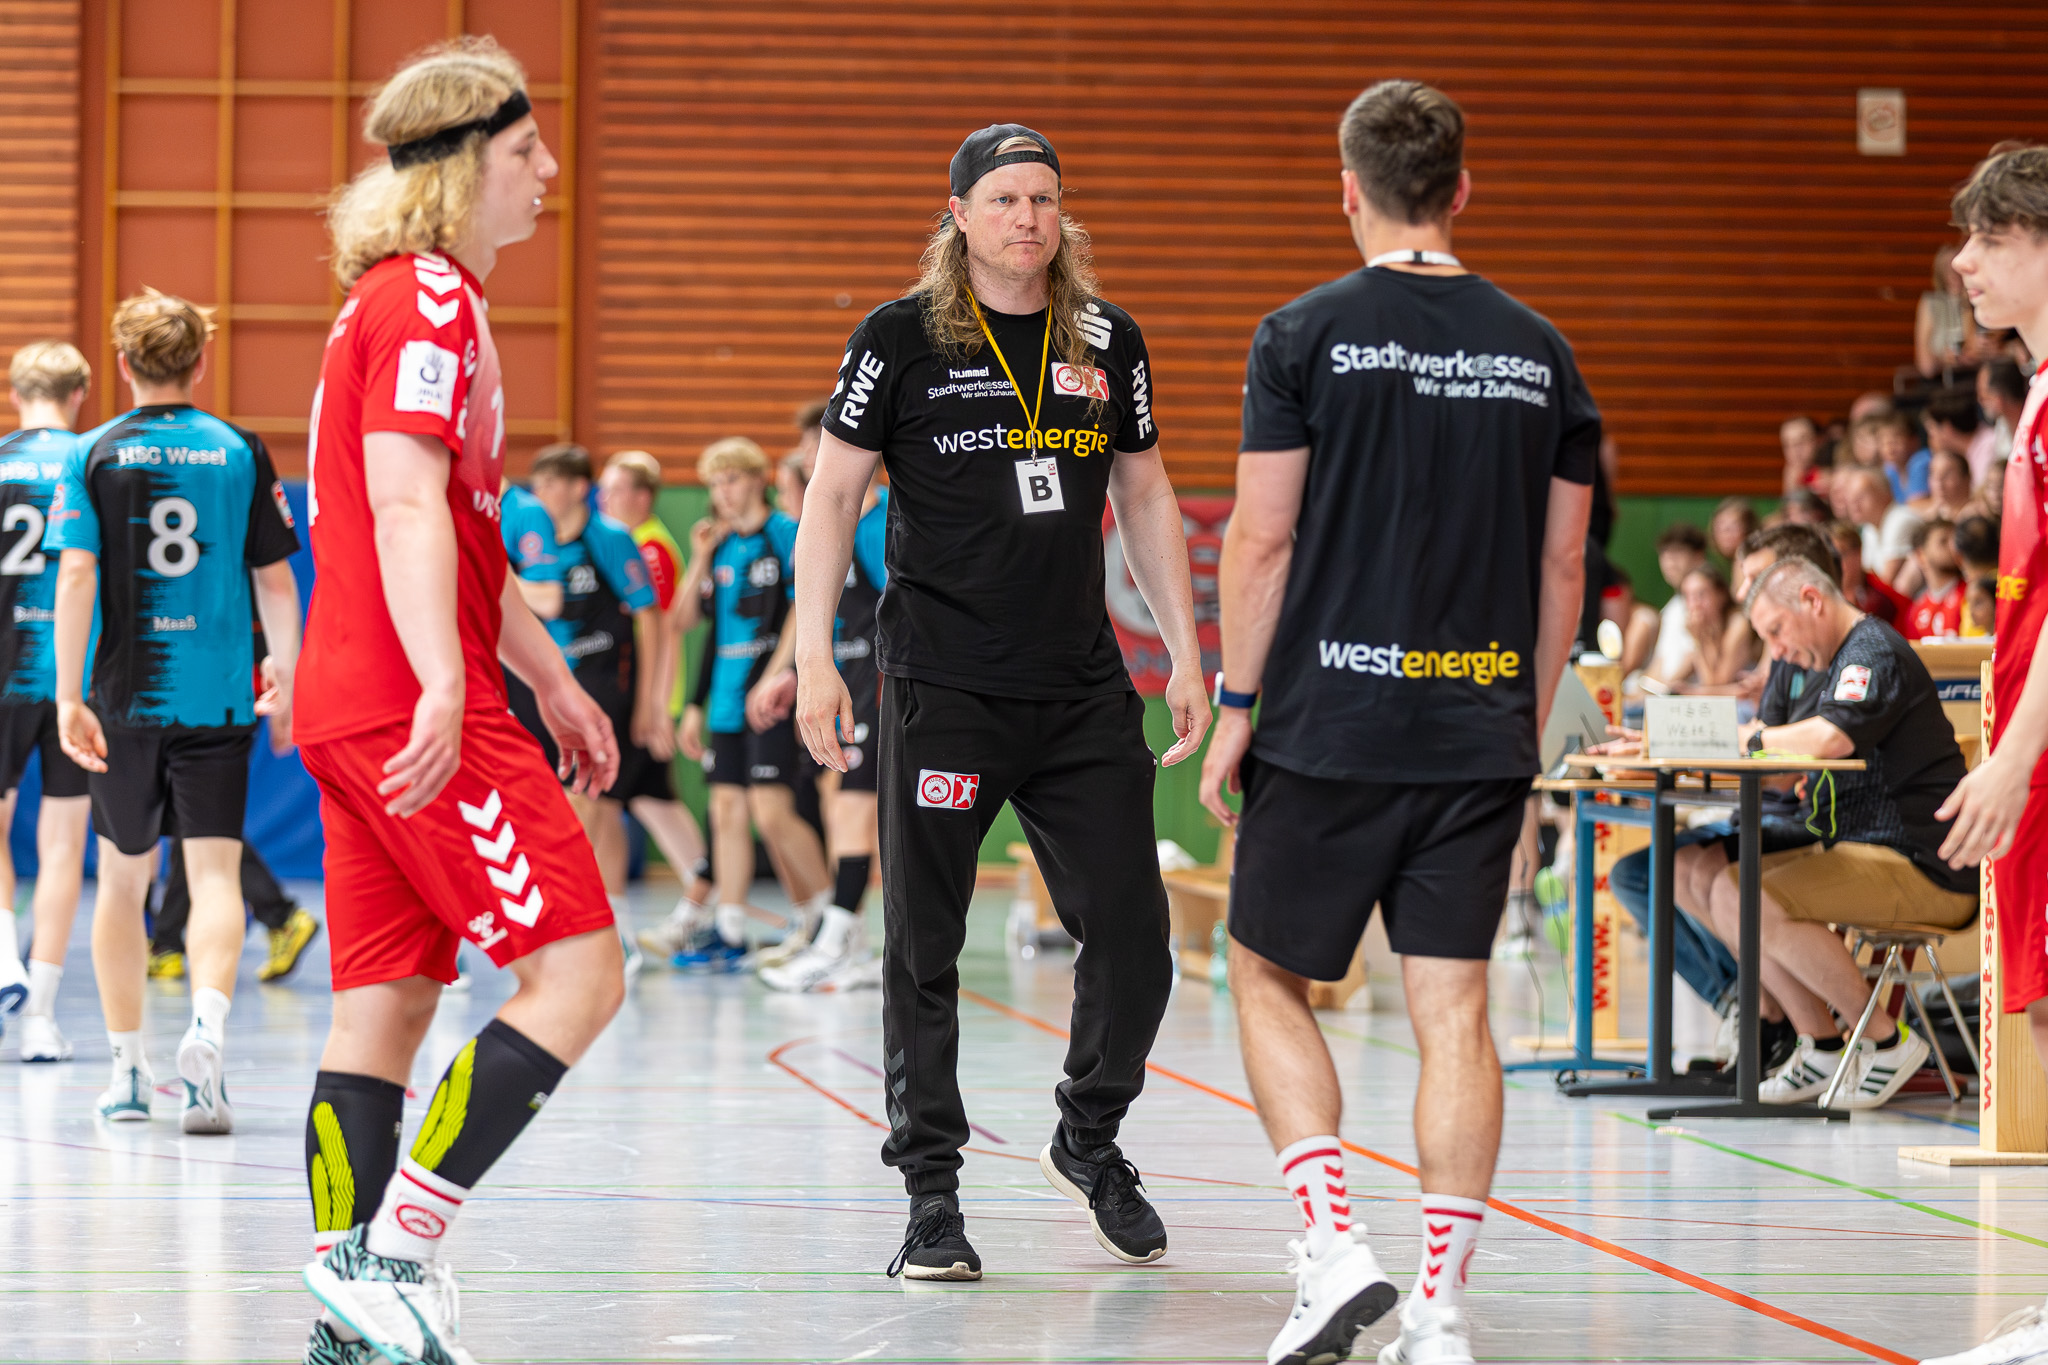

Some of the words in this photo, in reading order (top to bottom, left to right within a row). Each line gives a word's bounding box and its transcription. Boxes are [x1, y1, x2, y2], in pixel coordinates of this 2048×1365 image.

[949, 366, 990, 379] hummel
[1412, 376, 1441, 397] Wir
[1443, 379, 1480, 398] sind
[839, 350, 885, 429] RWE
[961, 391, 973, 399] Wir
[974, 390, 988, 398] sind
[1131, 360, 1152, 440] RWE
[933, 423, 1108, 457] westenergie
[164, 446, 228, 466] Wesel
[1028, 475, 1053, 502] B
[147, 496, 200, 578] 8
[1319, 639, 1520, 686] westenergie
